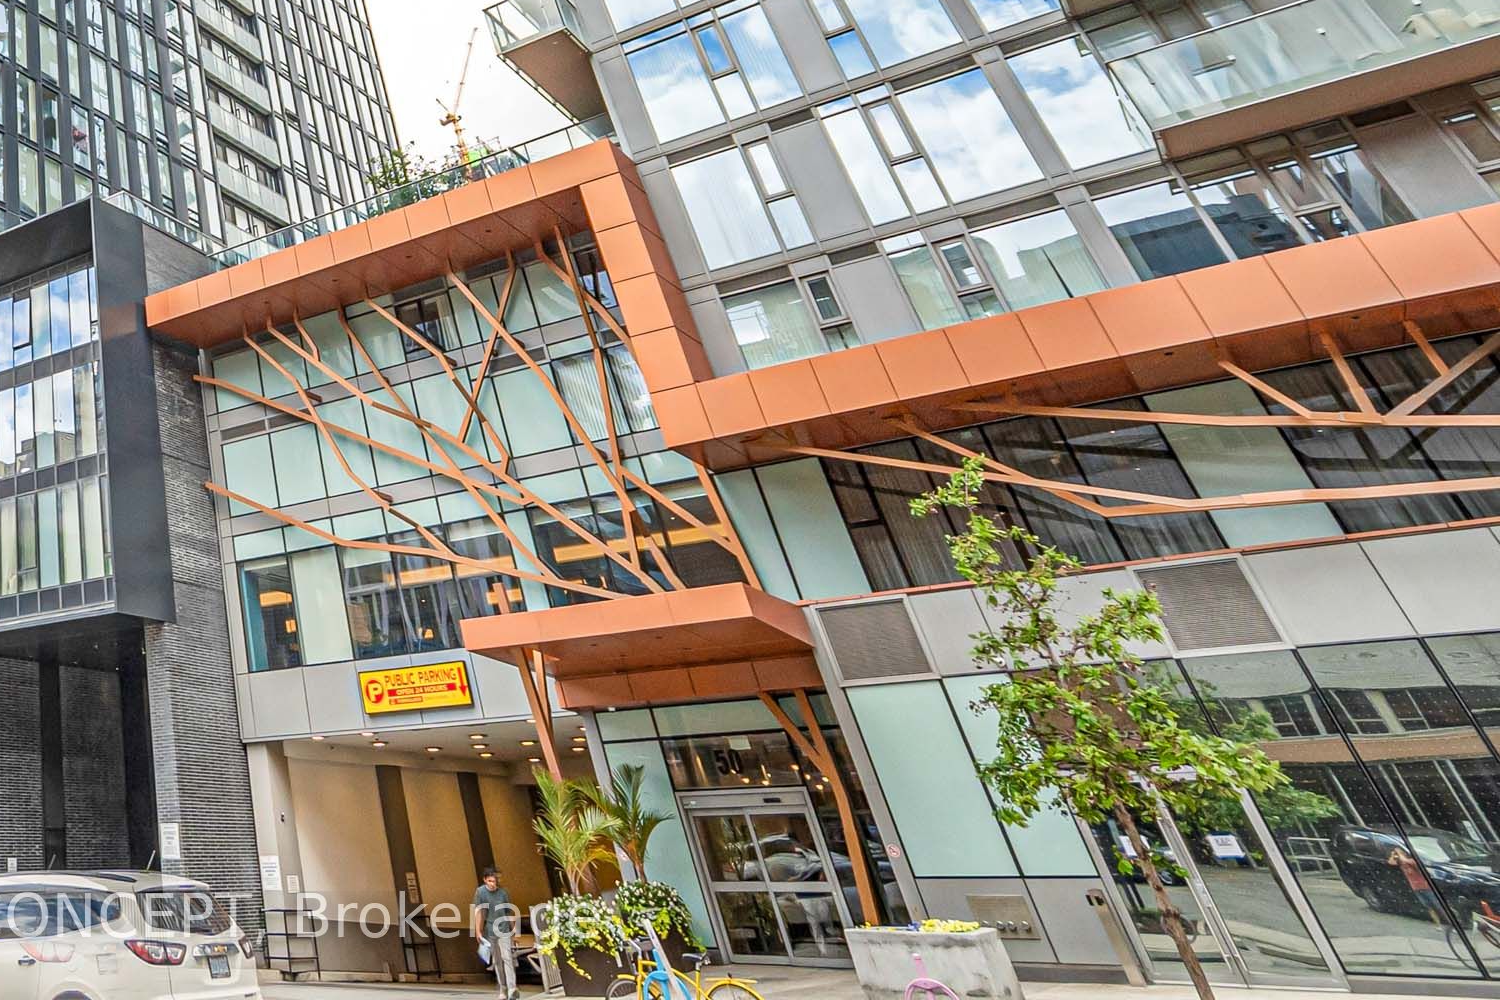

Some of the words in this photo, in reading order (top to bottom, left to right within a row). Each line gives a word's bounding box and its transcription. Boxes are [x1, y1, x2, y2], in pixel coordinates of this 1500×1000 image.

[384, 673, 415, 688] PUBLIC
[418, 668, 457, 684] PARKING
[714, 749, 744, 775] 50
